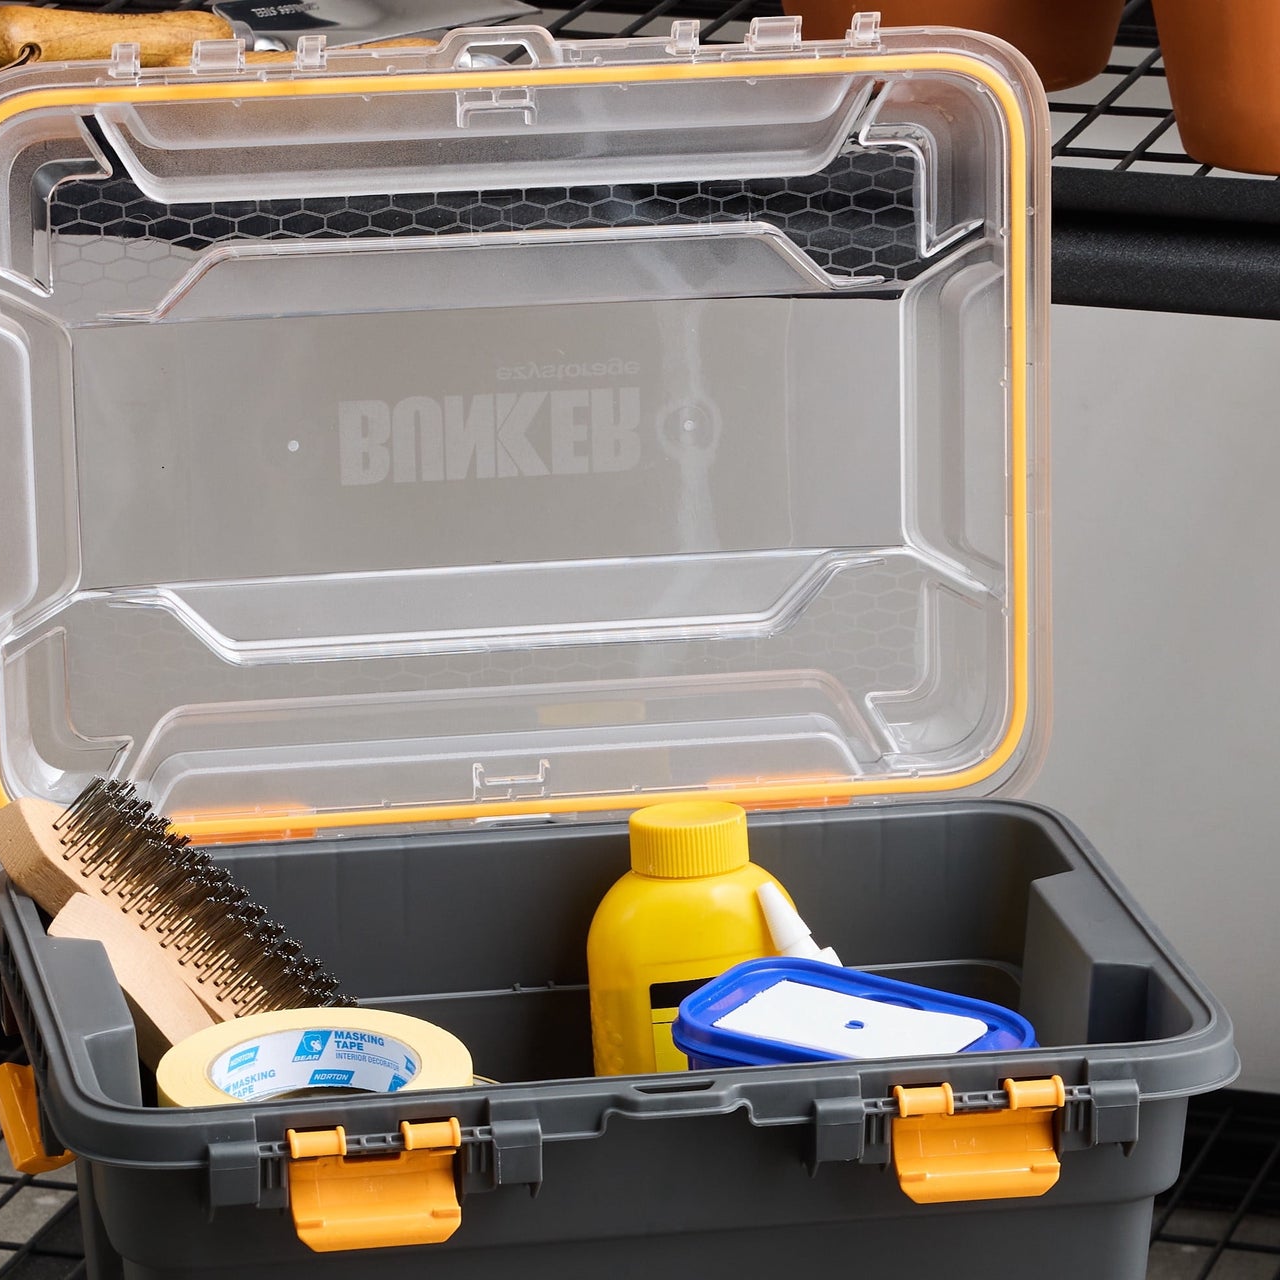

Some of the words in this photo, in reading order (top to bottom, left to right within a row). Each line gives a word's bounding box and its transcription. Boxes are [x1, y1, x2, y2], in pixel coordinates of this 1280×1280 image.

[334, 1030, 386, 1047] MASKING
[334, 1040, 365, 1051] TAPE
[293, 1054, 321, 1063] BEAR
[335, 1052, 367, 1063] INTERIOR
[231, 1068, 277, 1090] MASKING
[313, 1072, 350, 1082] NORTON
